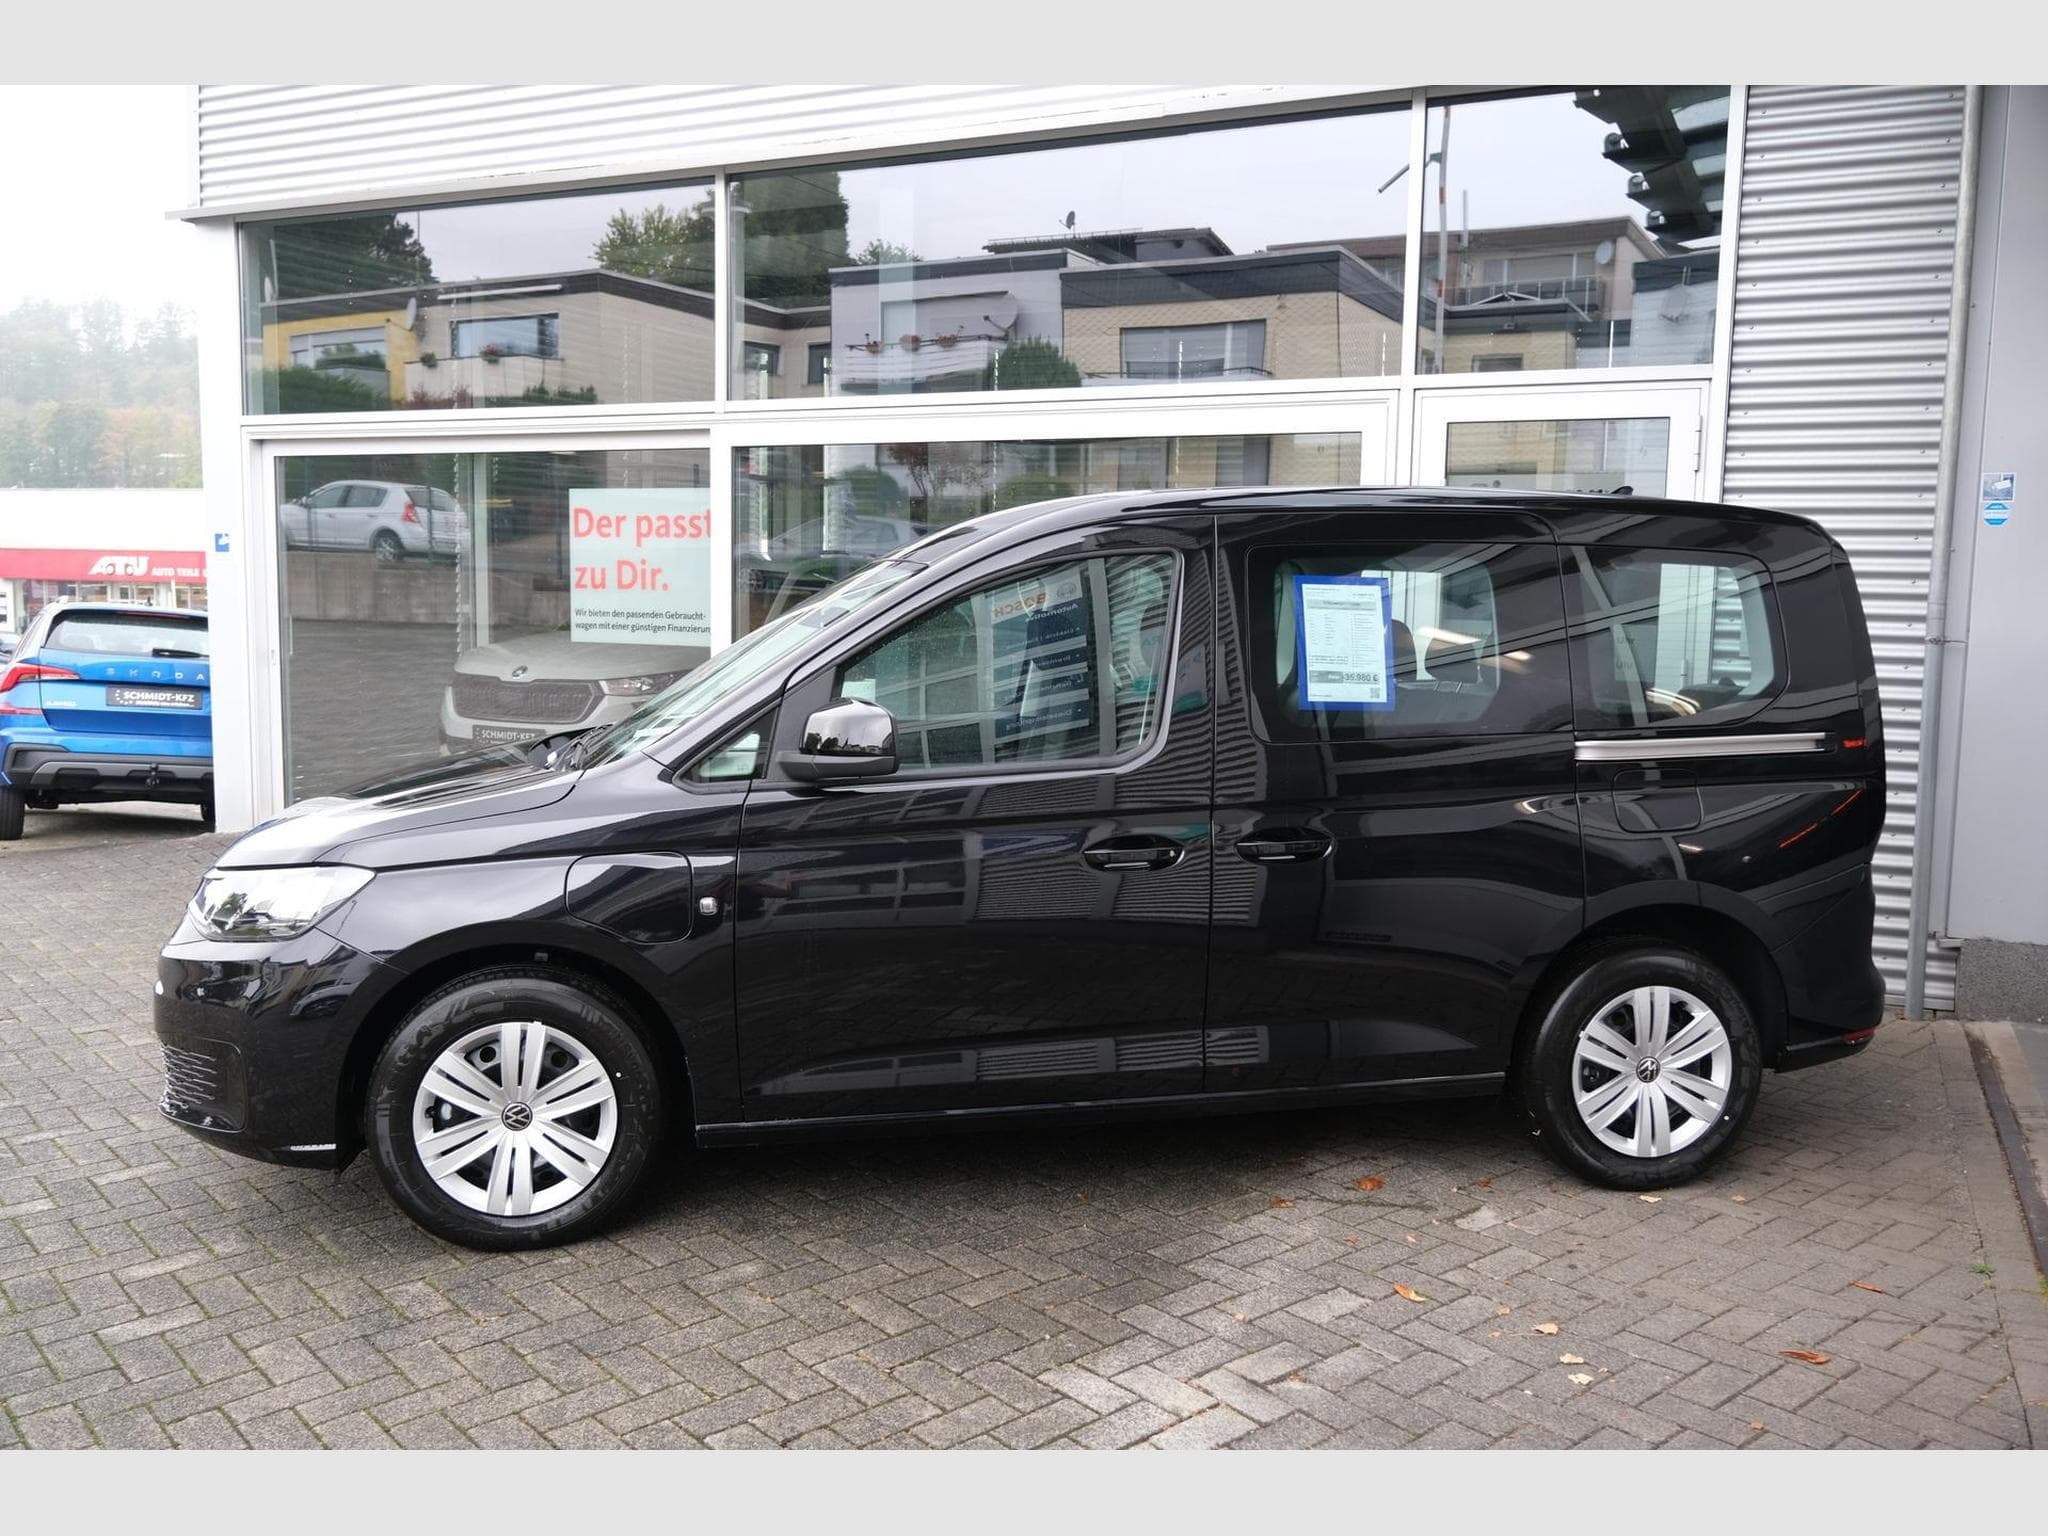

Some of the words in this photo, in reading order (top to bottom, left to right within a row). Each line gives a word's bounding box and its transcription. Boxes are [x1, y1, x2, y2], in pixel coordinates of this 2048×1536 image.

[574, 507, 627, 538] Der
[636, 509, 711, 548] passt
[88, 556, 150, 576] ATU
[575, 567, 607, 590] zu
[616, 558, 669, 591] Dir.
[575, 609, 587, 618] Wir
[588, 609, 611, 618] bieten
[612, 610, 625, 618] den
[626, 611, 664, 620] passenden
[664, 611, 706, 621] Gebraucht-
[575, 622, 598, 631] wagen
[599, 622, 611, 631] mit
[611, 623, 630, 631] einer
[631, 622, 667, 634] günstigen
[667, 624, 711, 634] Finanzierun
[123, 691, 195, 703] SCHMIDT-KFZ
